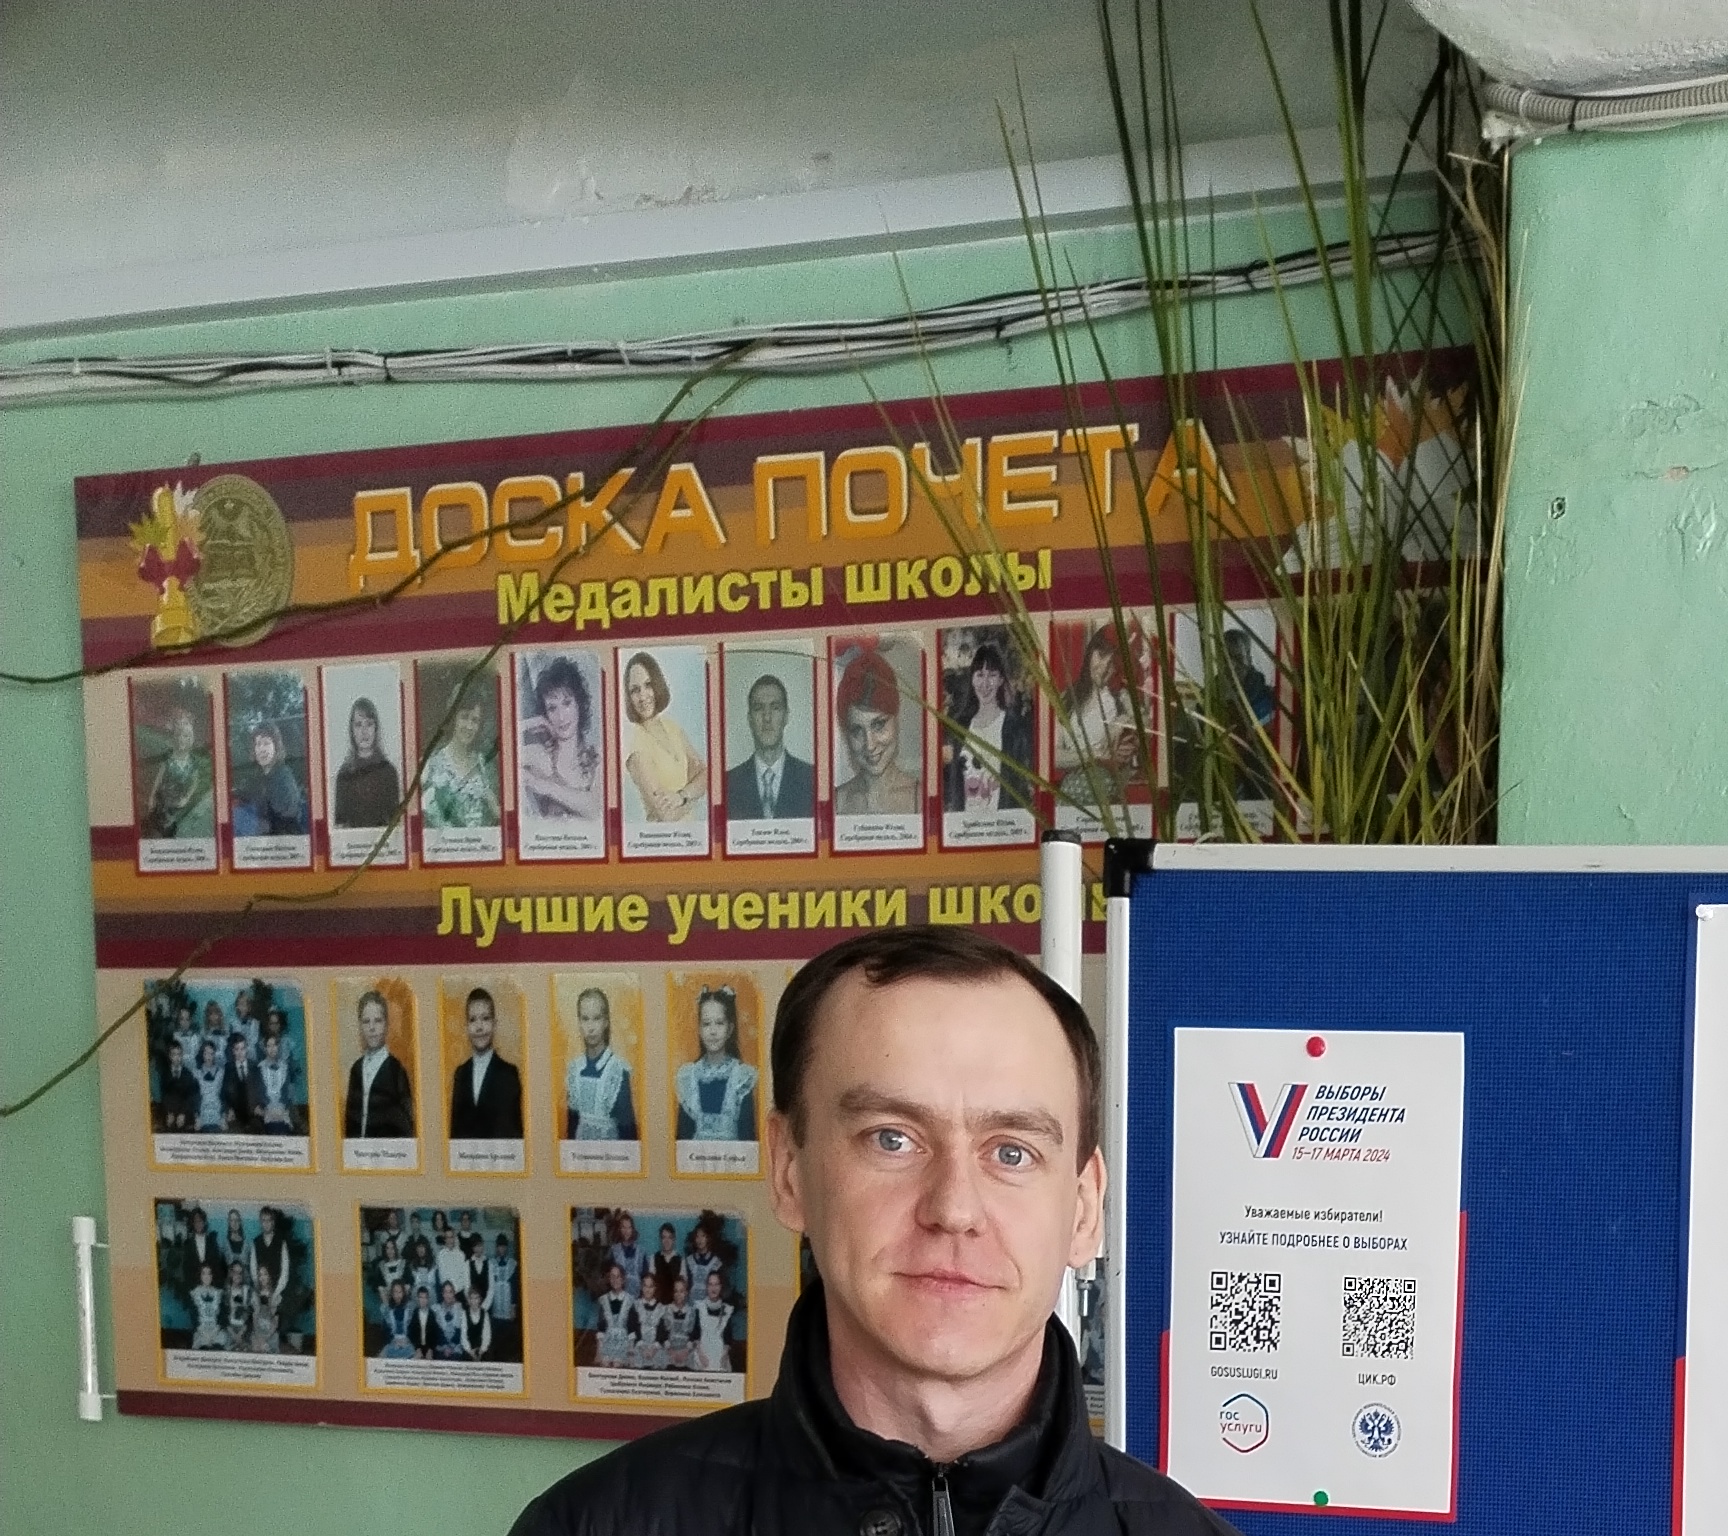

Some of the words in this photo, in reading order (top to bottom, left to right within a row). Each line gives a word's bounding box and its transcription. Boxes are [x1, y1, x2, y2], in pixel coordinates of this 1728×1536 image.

[347, 463, 729, 593] ДОСКА
[752, 417, 1238, 546] ПОЧЕТА
[496, 562, 825, 629] Медалисты
[844, 549, 1053, 604] школы
[437, 884, 650, 949] Лучшие
[667, 886, 907, 946] ученики
[929, 882, 1108, 925] шко
[1314, 1085, 1387, 1101] ВЫБОРЫ
[1306, 1105, 1406, 1124] ПРЕЗИДЕНТА
[1297, 1126, 1363, 1143] РОССИИ
[1322, 1147, 1362, 1162] МАРТА
[1362, 1148, 1391, 1162] 2024
[1244, 1205, 1311, 1220] Уважаемые
[1314, 1208, 1383, 1223] избиратели!
[1219, 1231, 1268, 1246] УЗНАЙТЕ
[1271, 1233, 1339, 1248] ПОДРОБНЕЕ
[1342, 1235, 1350, 1249] О
[1353, 1236, 1408, 1251] ВЫБОРАХ
[1210, 1366, 1278, 1380] GOSUSLUGI.RU
[1358, 1373, 1396, 1386] ЦИК.РФ
